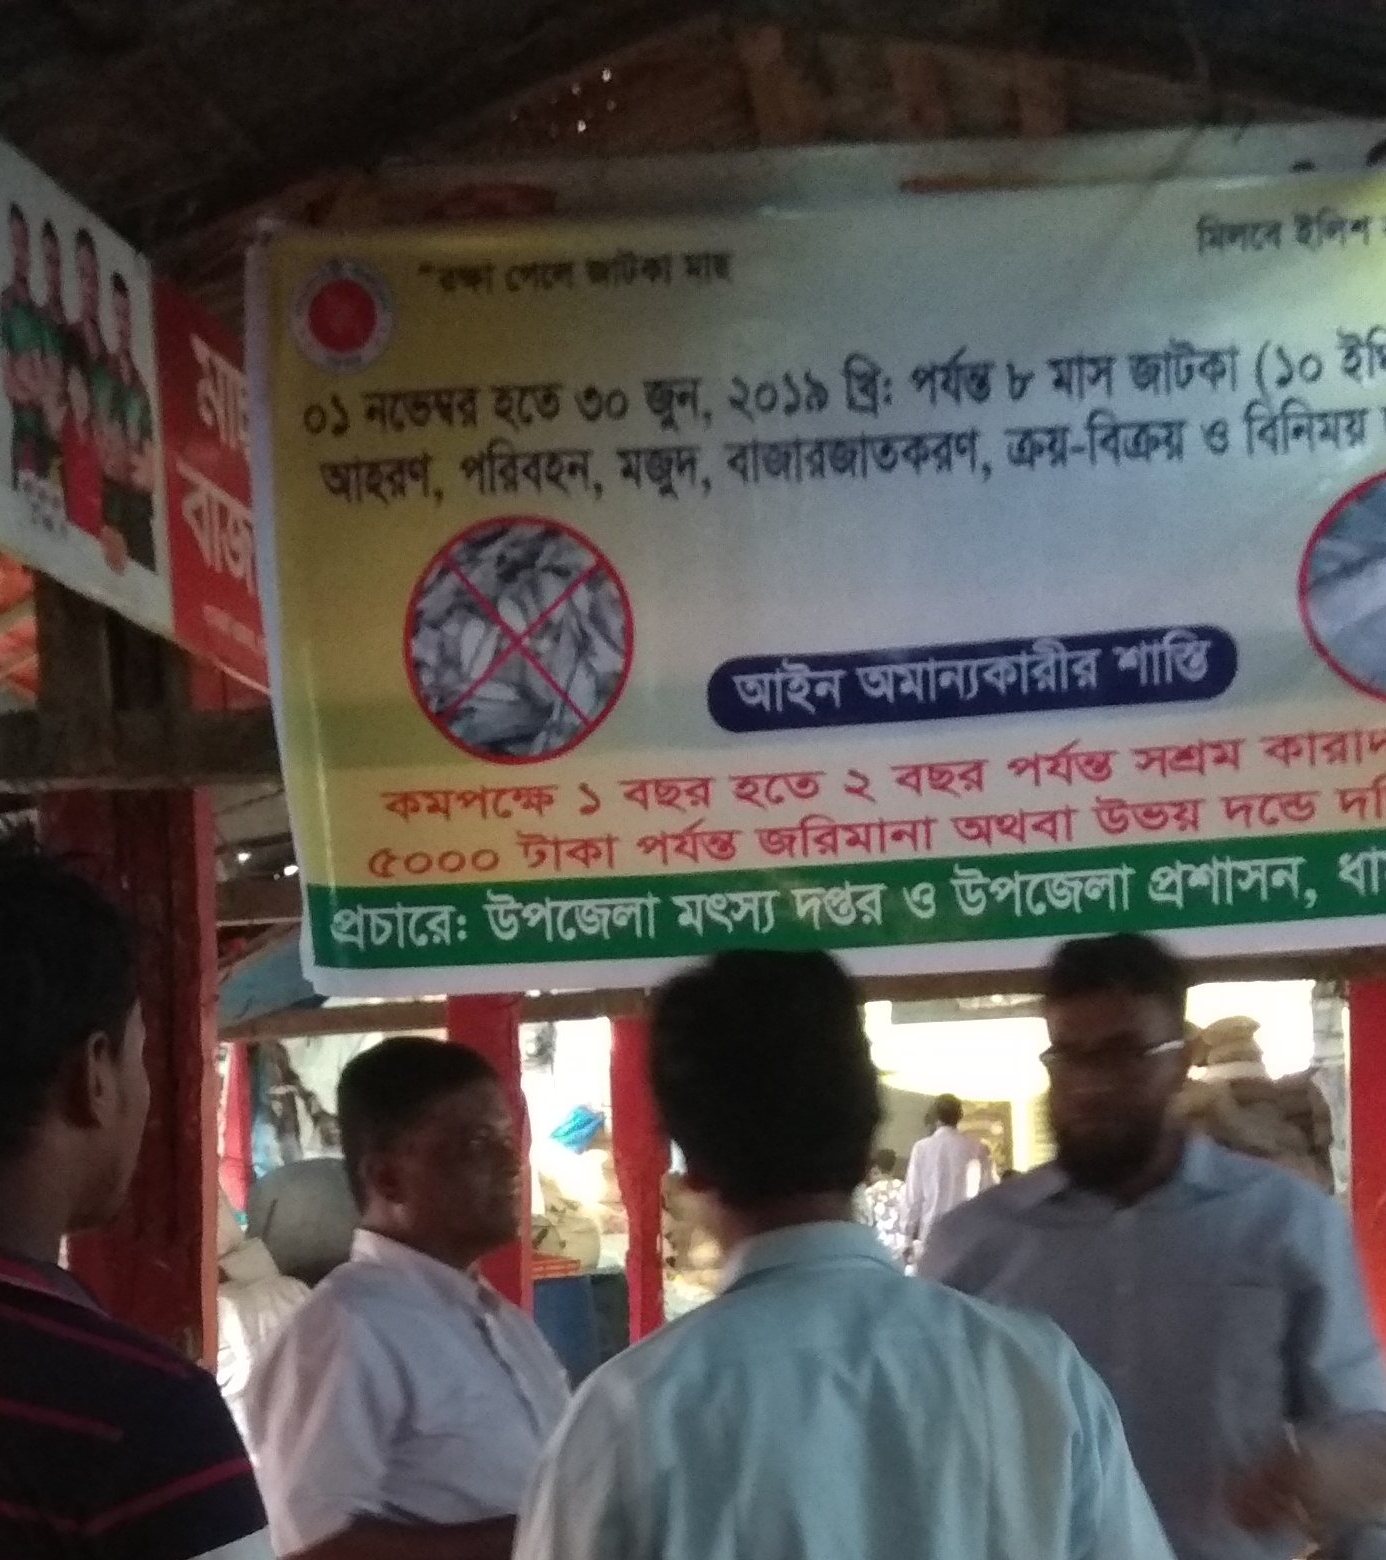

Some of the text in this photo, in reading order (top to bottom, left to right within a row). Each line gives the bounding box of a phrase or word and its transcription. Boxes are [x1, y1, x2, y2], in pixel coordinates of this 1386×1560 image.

[303, 394, 350, 435] ০১
[361, 385, 481, 433] নভেম্বর
[490, 382, 563, 432] হতে
[575, 384, 629, 422] ৩০
[642, 376, 712, 433] জুন,
[727, 367, 829, 424] ২০১৯
[909, 345, 996, 406] পর্যন্ত
[1006, 359, 1035, 402] ৮
[1046, 352, 1116, 401] মাস
[1127, 336, 1240, 394] জাটকা
[1255, 338, 1323, 400] (১০
[319, 450, 444, 505] আহরণ,
[459, 437, 604, 501] পরিবহন,
[615, 445, 712, 500] মজুদ,
[723, 426, 992, 488] বাজারজাতকরণ,
[1201, 415, 1231, 457] ও
[1243, 396, 1370, 457] বিনিময়
[733, 657, 846, 713] আইন
[855, 636, 1102, 703] অমান্যকারীর
[380, 784, 559, 824] কমপক্ষে
[578, 782, 602, 816] ১
[617, 776, 715, 814] বছর
[728, 770, 826, 811] হতে
[843, 769, 877, 804] ২
[891, 759, 989, 797] বছর
[1006, 738, 1118, 787] পর্যন্ত
[1130, 737, 1246, 778] সশ্রম
[367, 848, 500, 879] ৫০০০
[516, 830, 619, 871] টাকা
[635, 817, 744, 863] পর্যন্ত
[753, 813, 938, 858] জরিমানা
[949, 808, 1080, 848] অথবা
[1091, 796, 1206, 835] উভয়
[481, 888, 662, 943] উপজেলা
[669, 888, 783, 937] মৎস্য
[789, 880, 889, 930] দপ্তর
[902, 880, 938, 921] ও
[949, 863, 1137, 919] উপজেলা
[1147, 855, 1319, 910] প্রশাসন,
